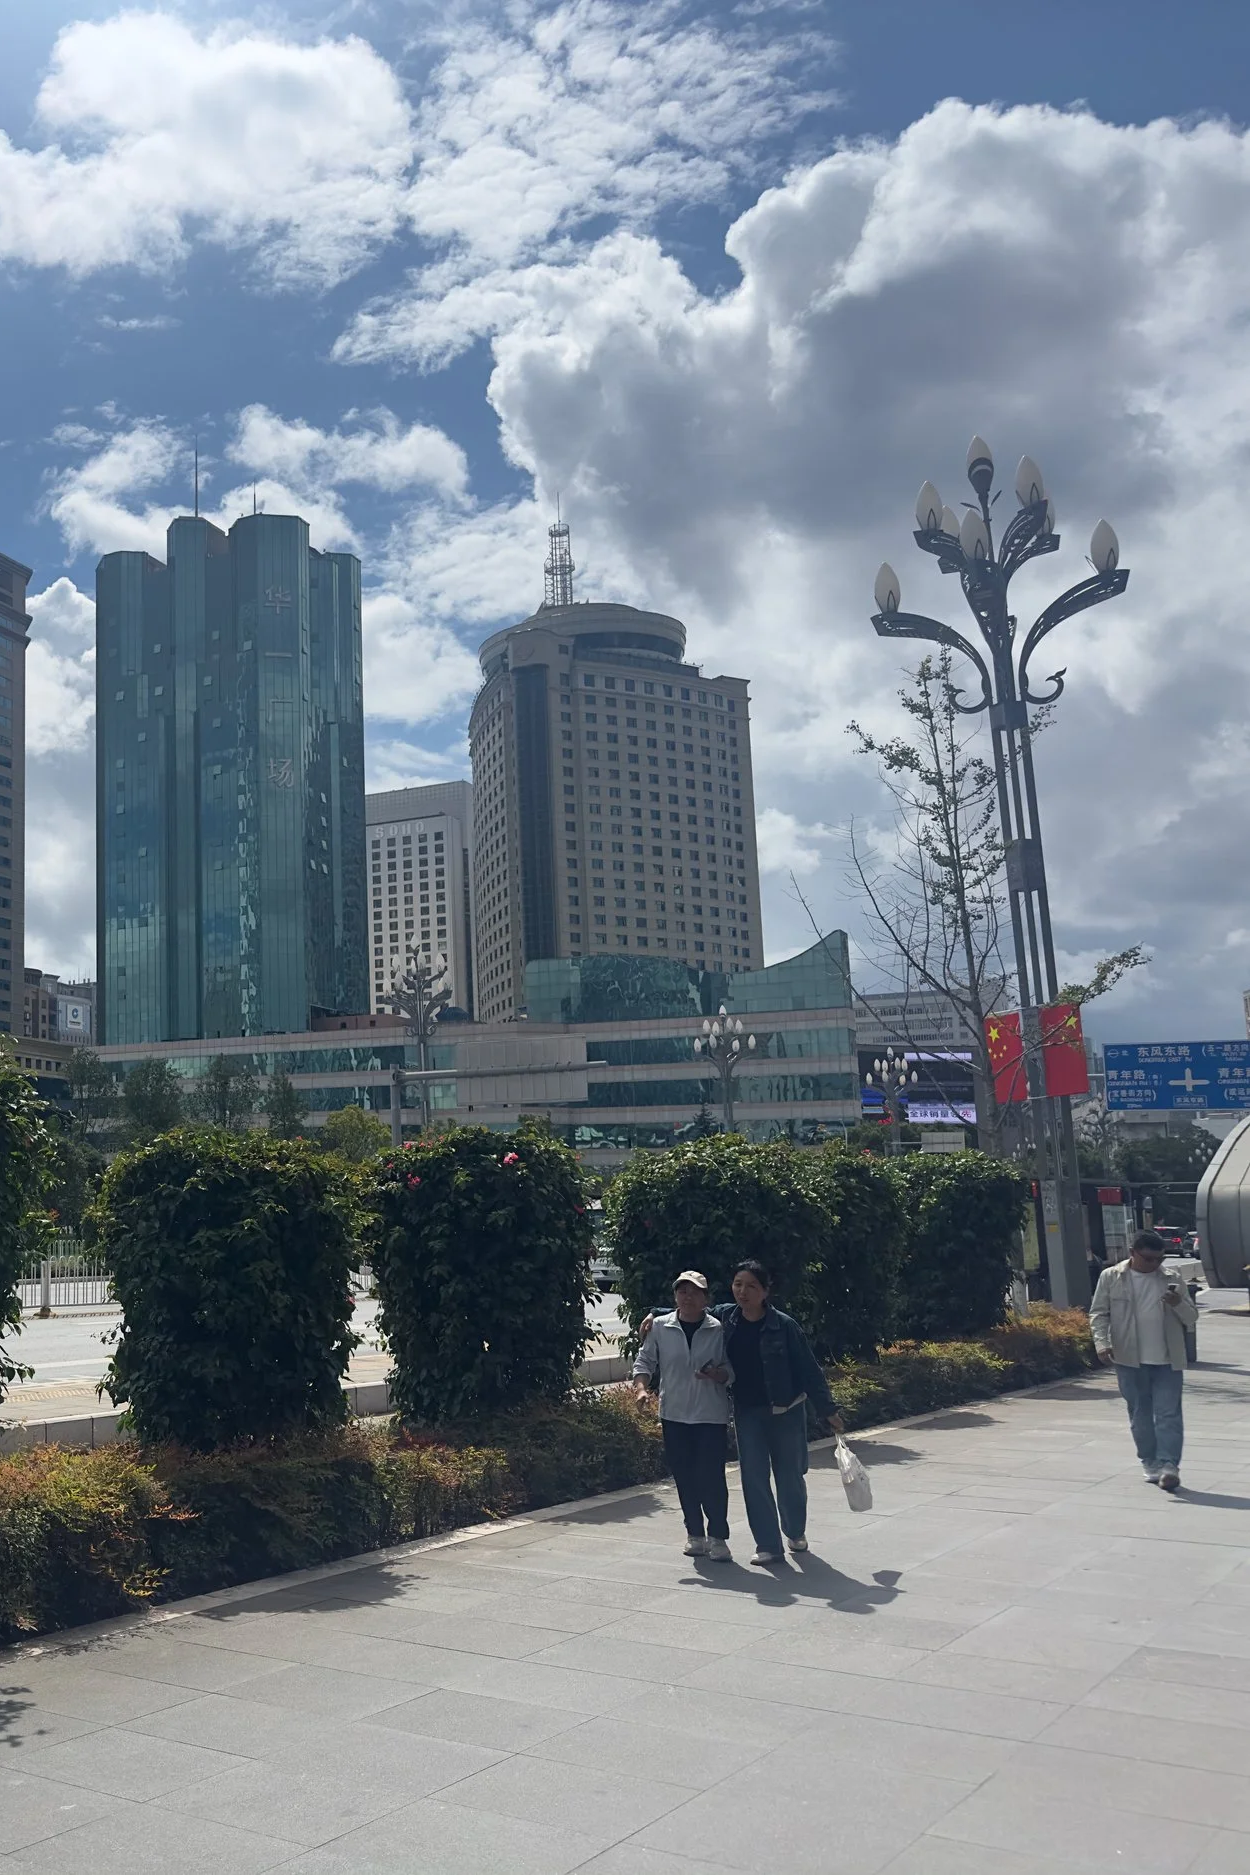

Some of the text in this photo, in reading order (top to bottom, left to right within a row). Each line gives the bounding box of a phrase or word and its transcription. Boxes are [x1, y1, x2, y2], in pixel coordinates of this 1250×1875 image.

[375, 821, 425, 838] SOHO
[1137, 1045, 1190, 1057] 东风东路
[1107, 1070, 1145, 1080] 青年路
